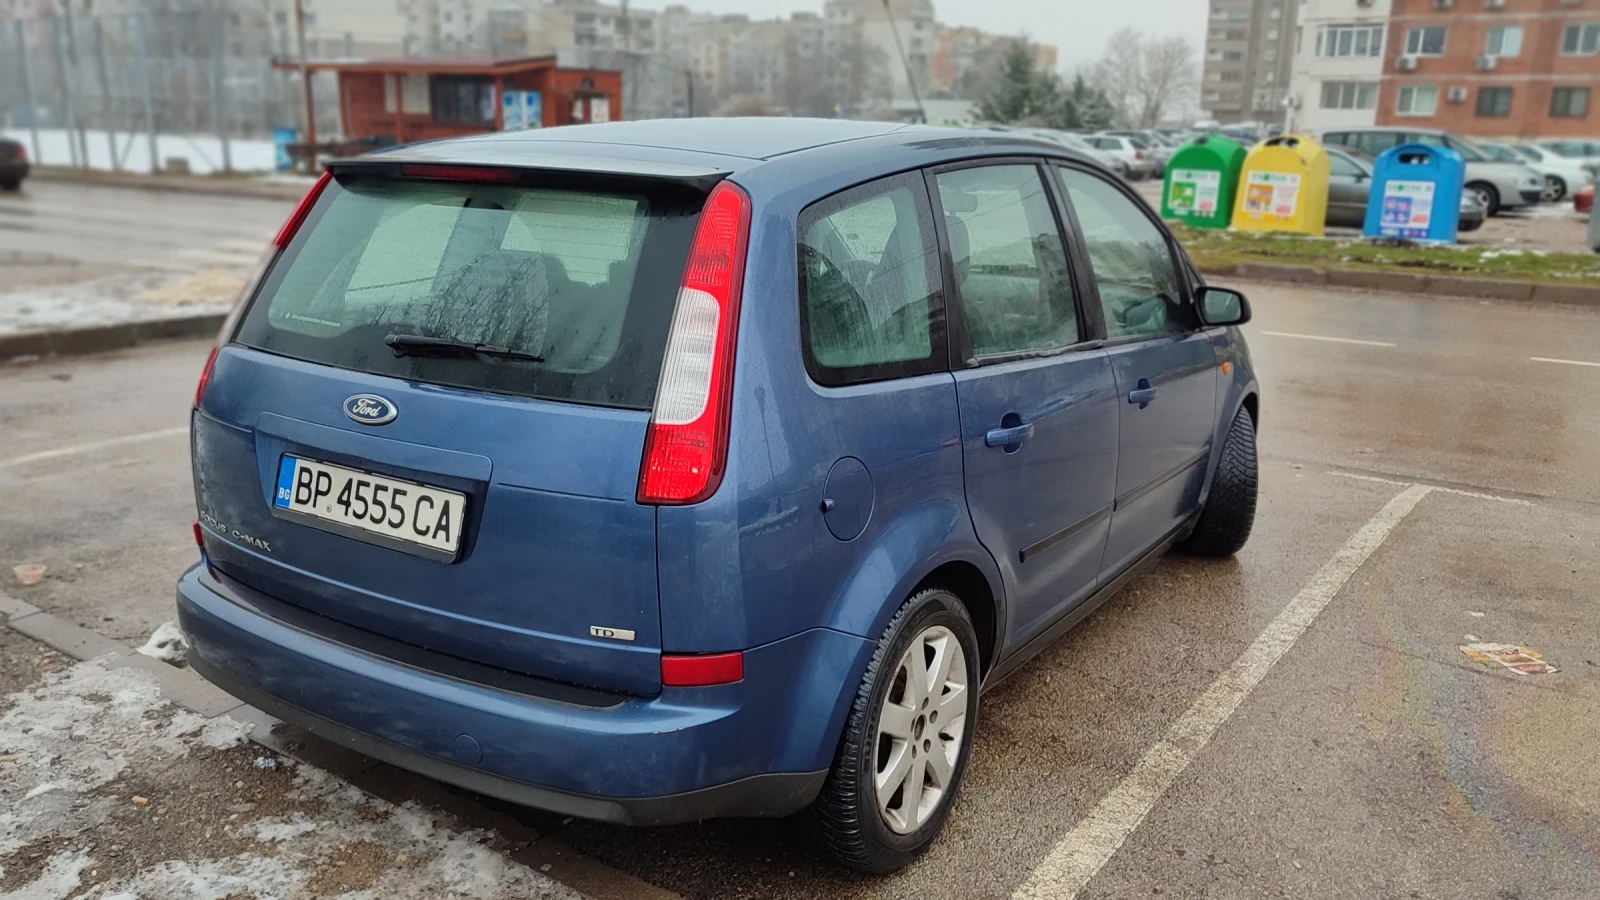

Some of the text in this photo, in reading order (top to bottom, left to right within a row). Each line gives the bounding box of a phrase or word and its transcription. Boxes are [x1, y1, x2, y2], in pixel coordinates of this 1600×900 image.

[352, 398, 382, 417] Ford
[278, 466, 451, 542] BG BP 4555 CA
[199, 510, 271, 552] FOCUS C-MAX
